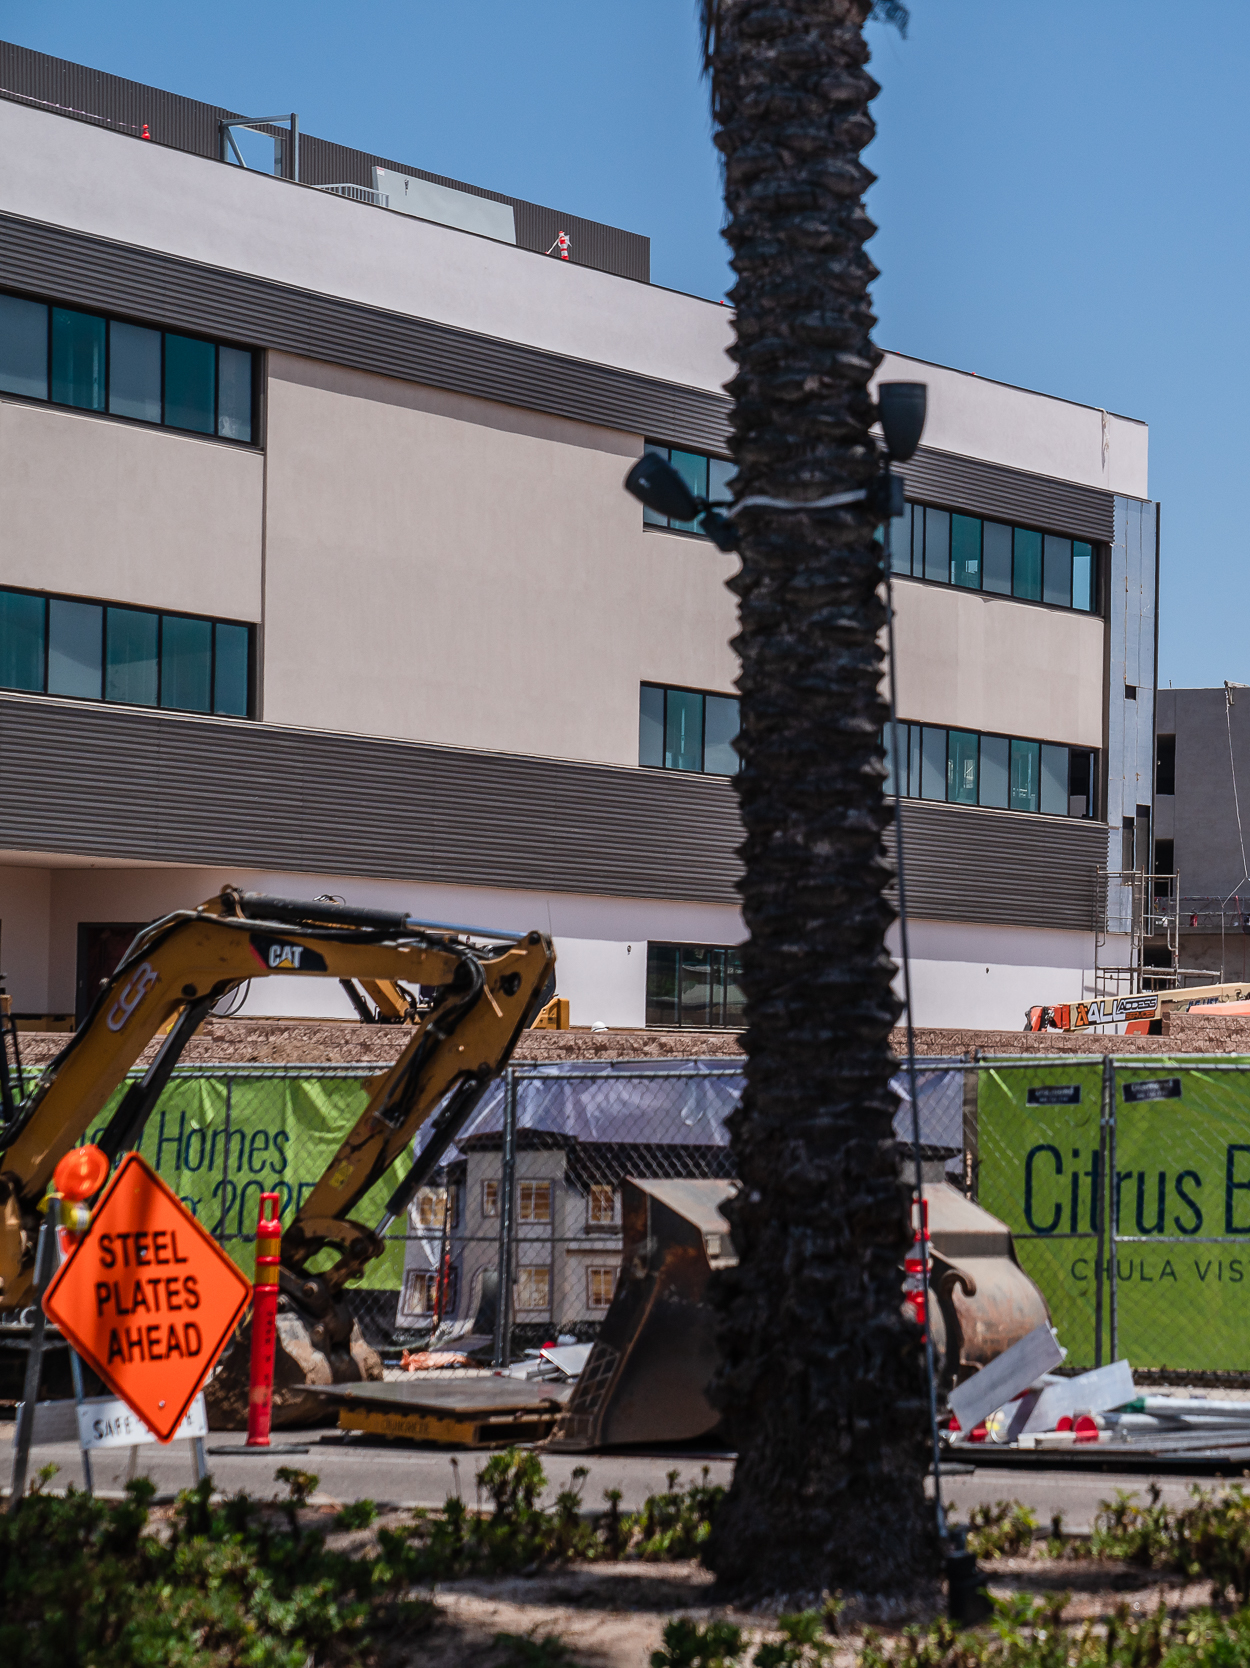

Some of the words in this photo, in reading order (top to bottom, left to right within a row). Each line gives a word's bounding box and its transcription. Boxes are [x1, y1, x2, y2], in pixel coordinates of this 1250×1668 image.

[268, 944, 304, 968] CAT
[156, 1110, 289, 1174] Homes
[1023, 1144, 1203, 1235] Citrus
[98, 1230, 189, 1269] STEEL
[1070, 1258, 1178, 1283] CHULA
[95, 1275, 201, 1318] PLATES
[107, 1321, 204, 1365] AHEAD
